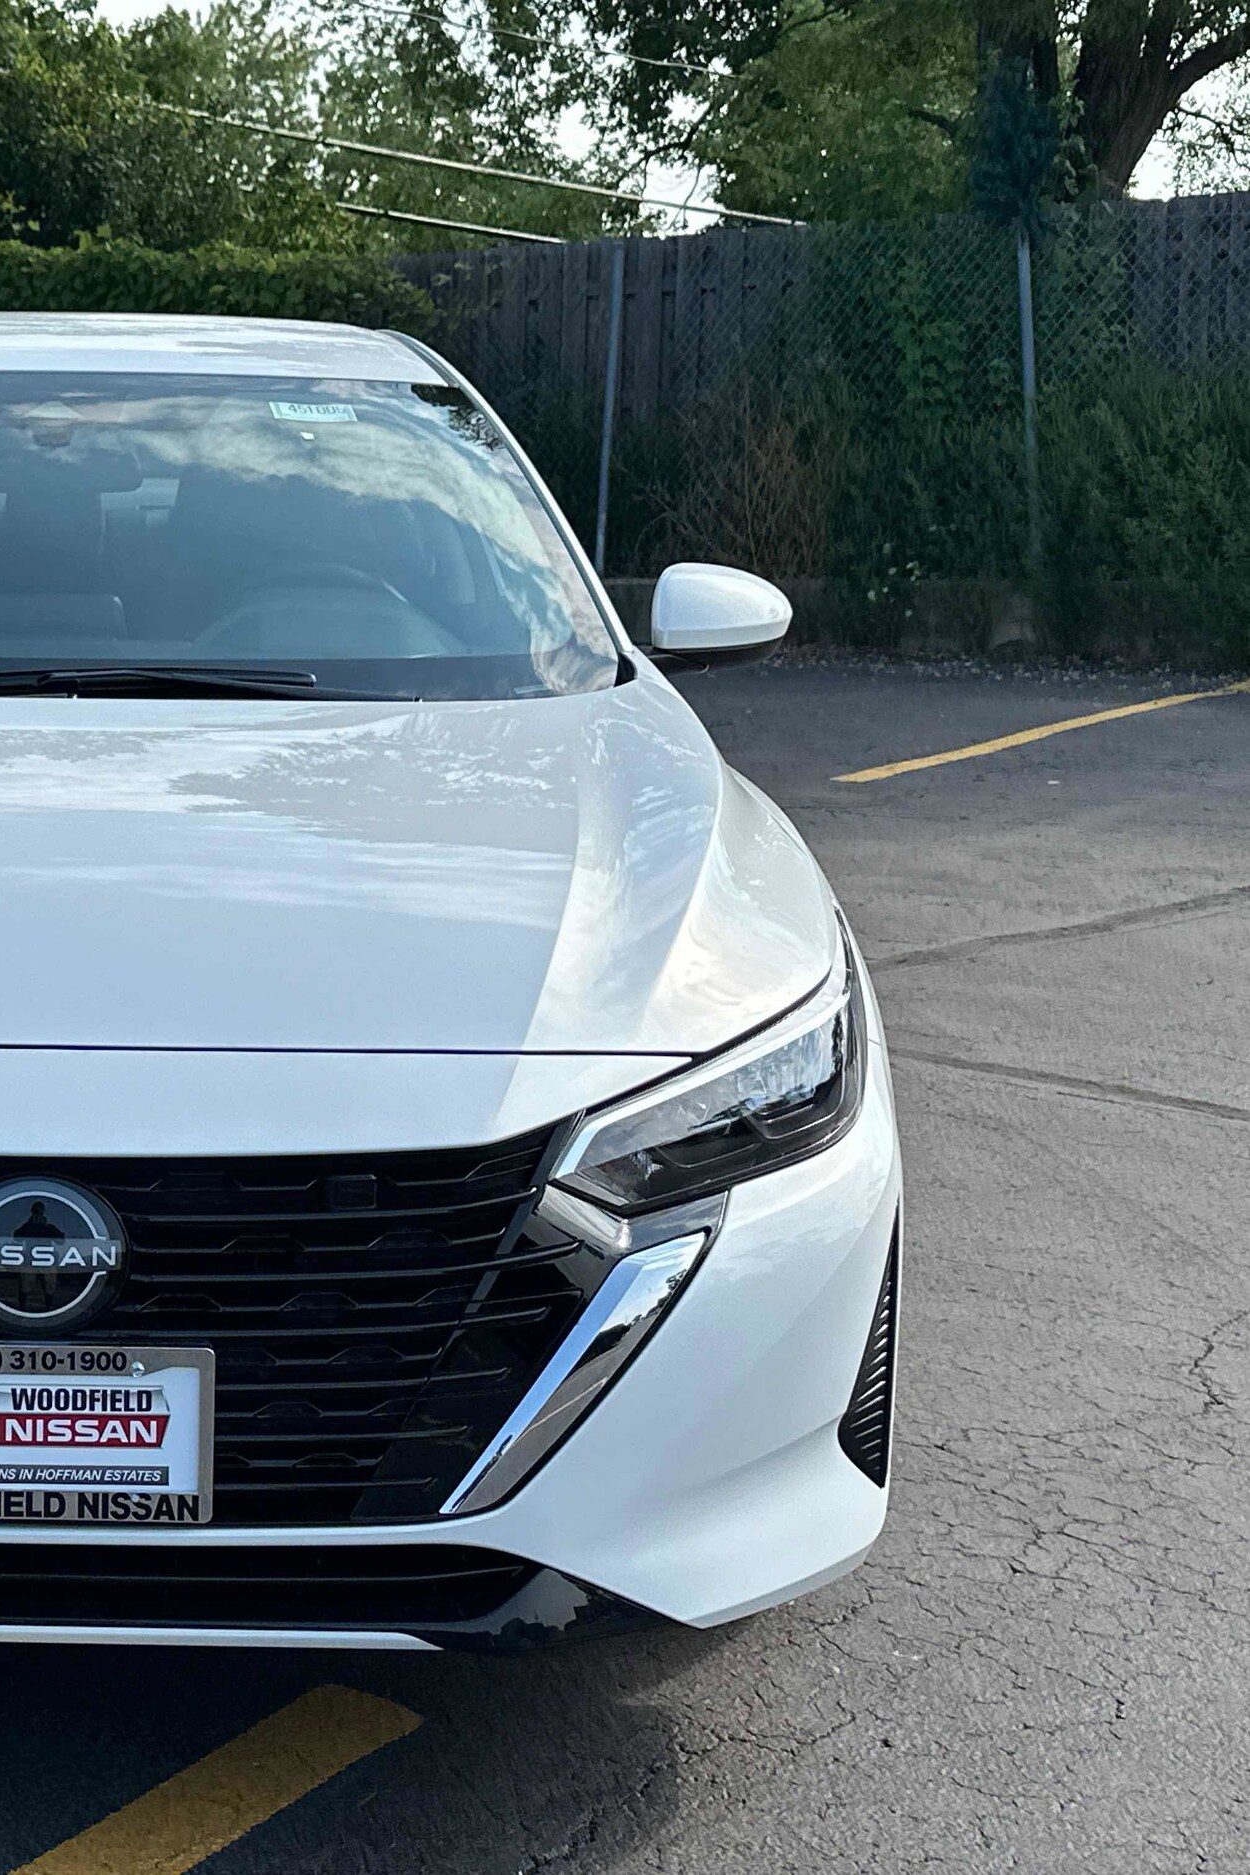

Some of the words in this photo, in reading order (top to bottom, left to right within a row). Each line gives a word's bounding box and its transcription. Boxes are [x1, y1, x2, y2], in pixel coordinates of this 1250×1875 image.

[9, 1350, 128, 1372] 310-1900
[10, 1387, 153, 1413] WOODFIELD
[4, 1419, 158, 1444] NISSAN
[19, 1469, 34, 1480] IN
[36, 1469, 101, 1481] HOFFMAN
[103, 1470, 162, 1482] ESTATES
[77, 1493, 200, 1521] NISSAN
